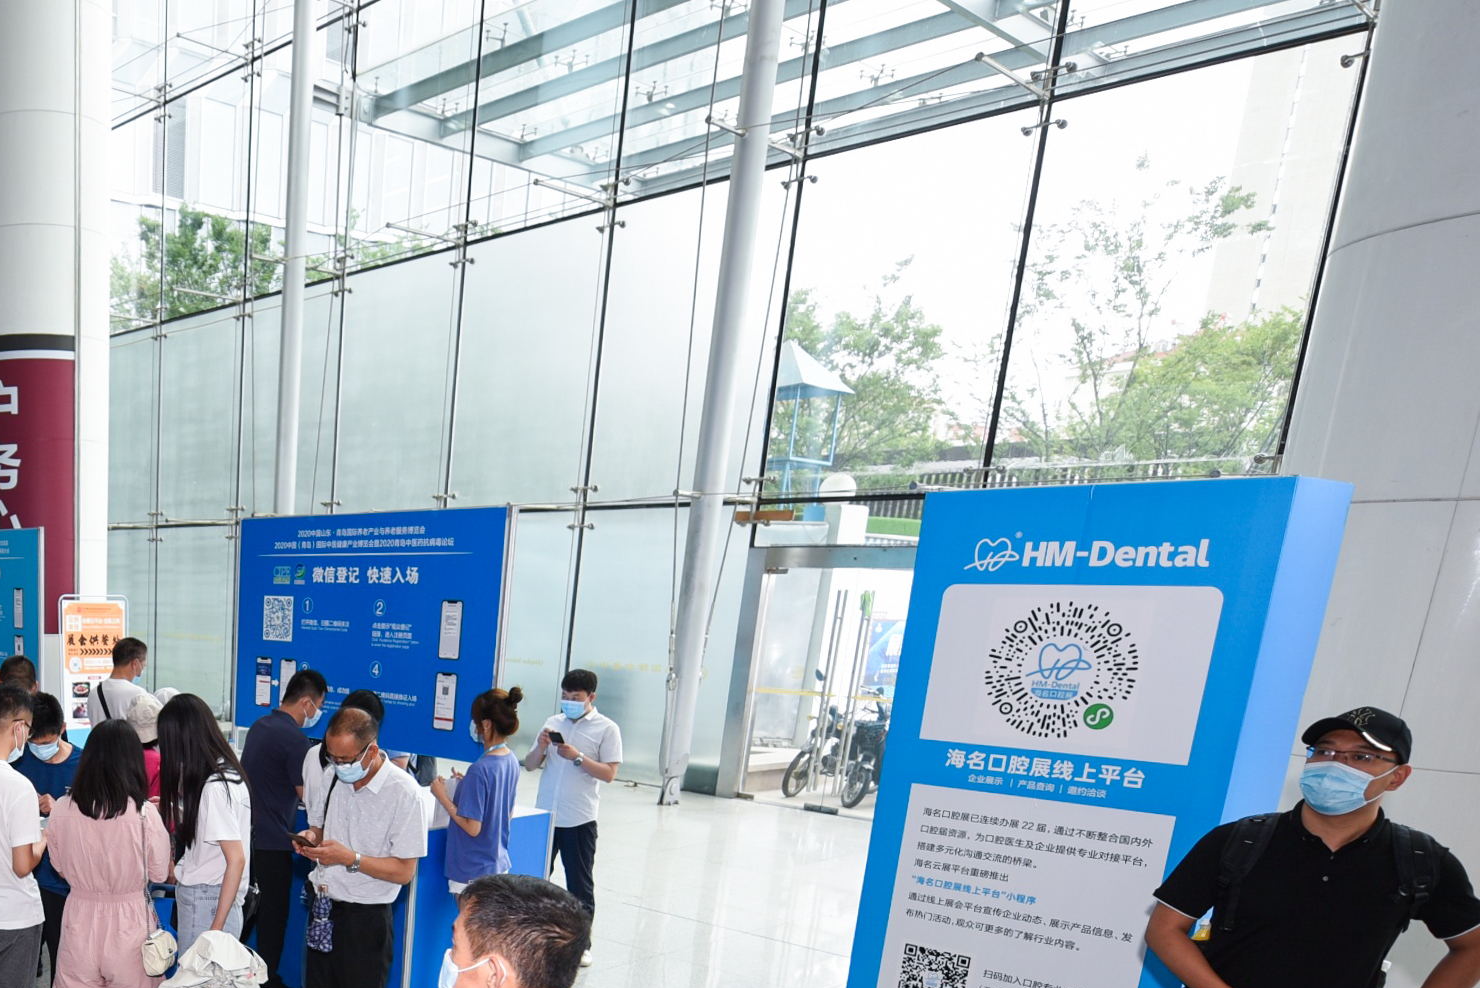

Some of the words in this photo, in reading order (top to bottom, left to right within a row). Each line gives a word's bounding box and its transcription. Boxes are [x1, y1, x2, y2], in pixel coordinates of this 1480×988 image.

[1022, 538, 1210, 568] HM-Dental
[312, 566, 360, 584] 微信登记
[366, 566, 419, 584] 快速入场
[1031, 680, 1080, 690] HM-Dental
[945, 748, 1146, 789] 海名口腔展线上平台
[968, 774, 1003, 785] 企业展示
[1017, 780, 1055, 793] 产品查询
[914, 857, 1009, 882] 海名云展平台重磅推出
